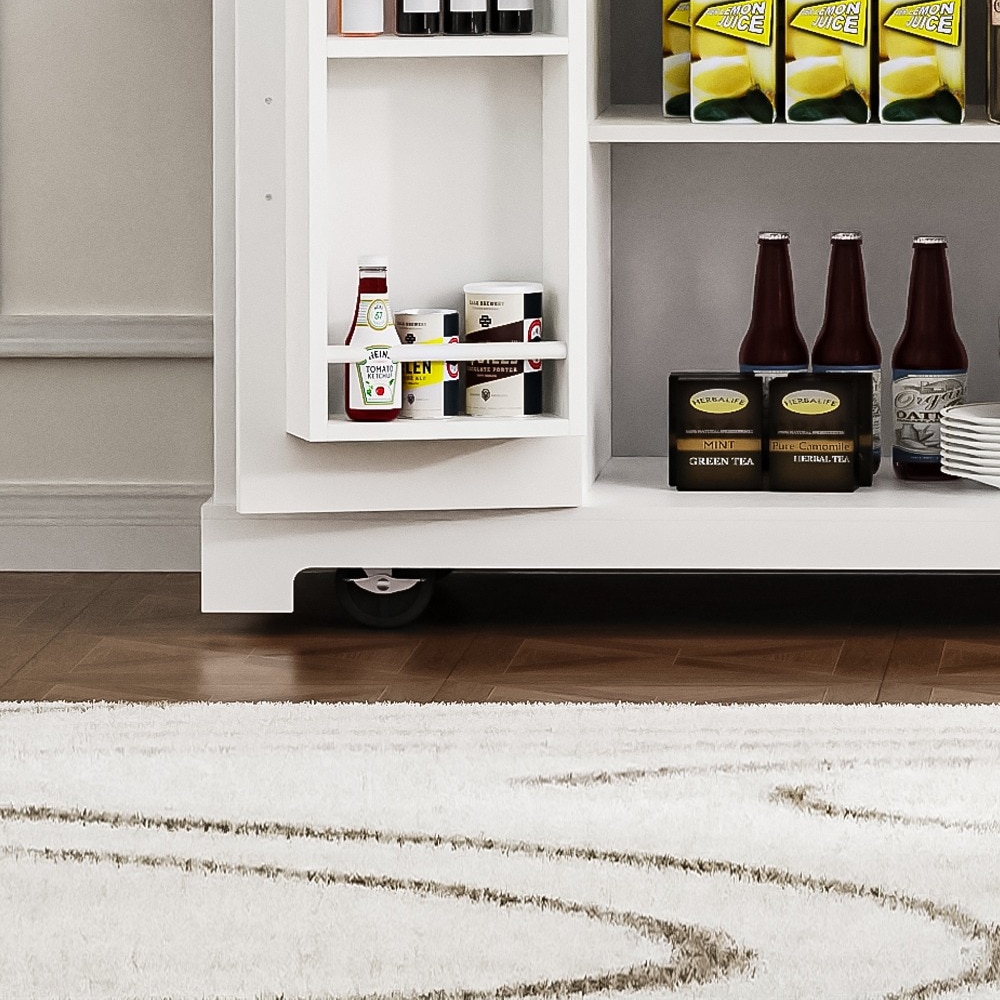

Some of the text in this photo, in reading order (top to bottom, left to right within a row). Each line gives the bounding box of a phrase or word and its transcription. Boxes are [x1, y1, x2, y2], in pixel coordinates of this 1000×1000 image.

[717, 15, 765, 33] JUICE
[811, 15, 859, 33] JUICE
[905, 15, 953, 33] JUICE
[366, 365, 394, 373] TOMATO
[691, 397, 747, 406] HERBALIFE
[783, 398, 838, 407] HERBALIFE
[703, 440, 735, 449] MINT
[772, 441, 795, 451] Pure
[689, 457, 755, 466] GREEN TEA
[793, 455, 851, 463] HERBAL TEA
